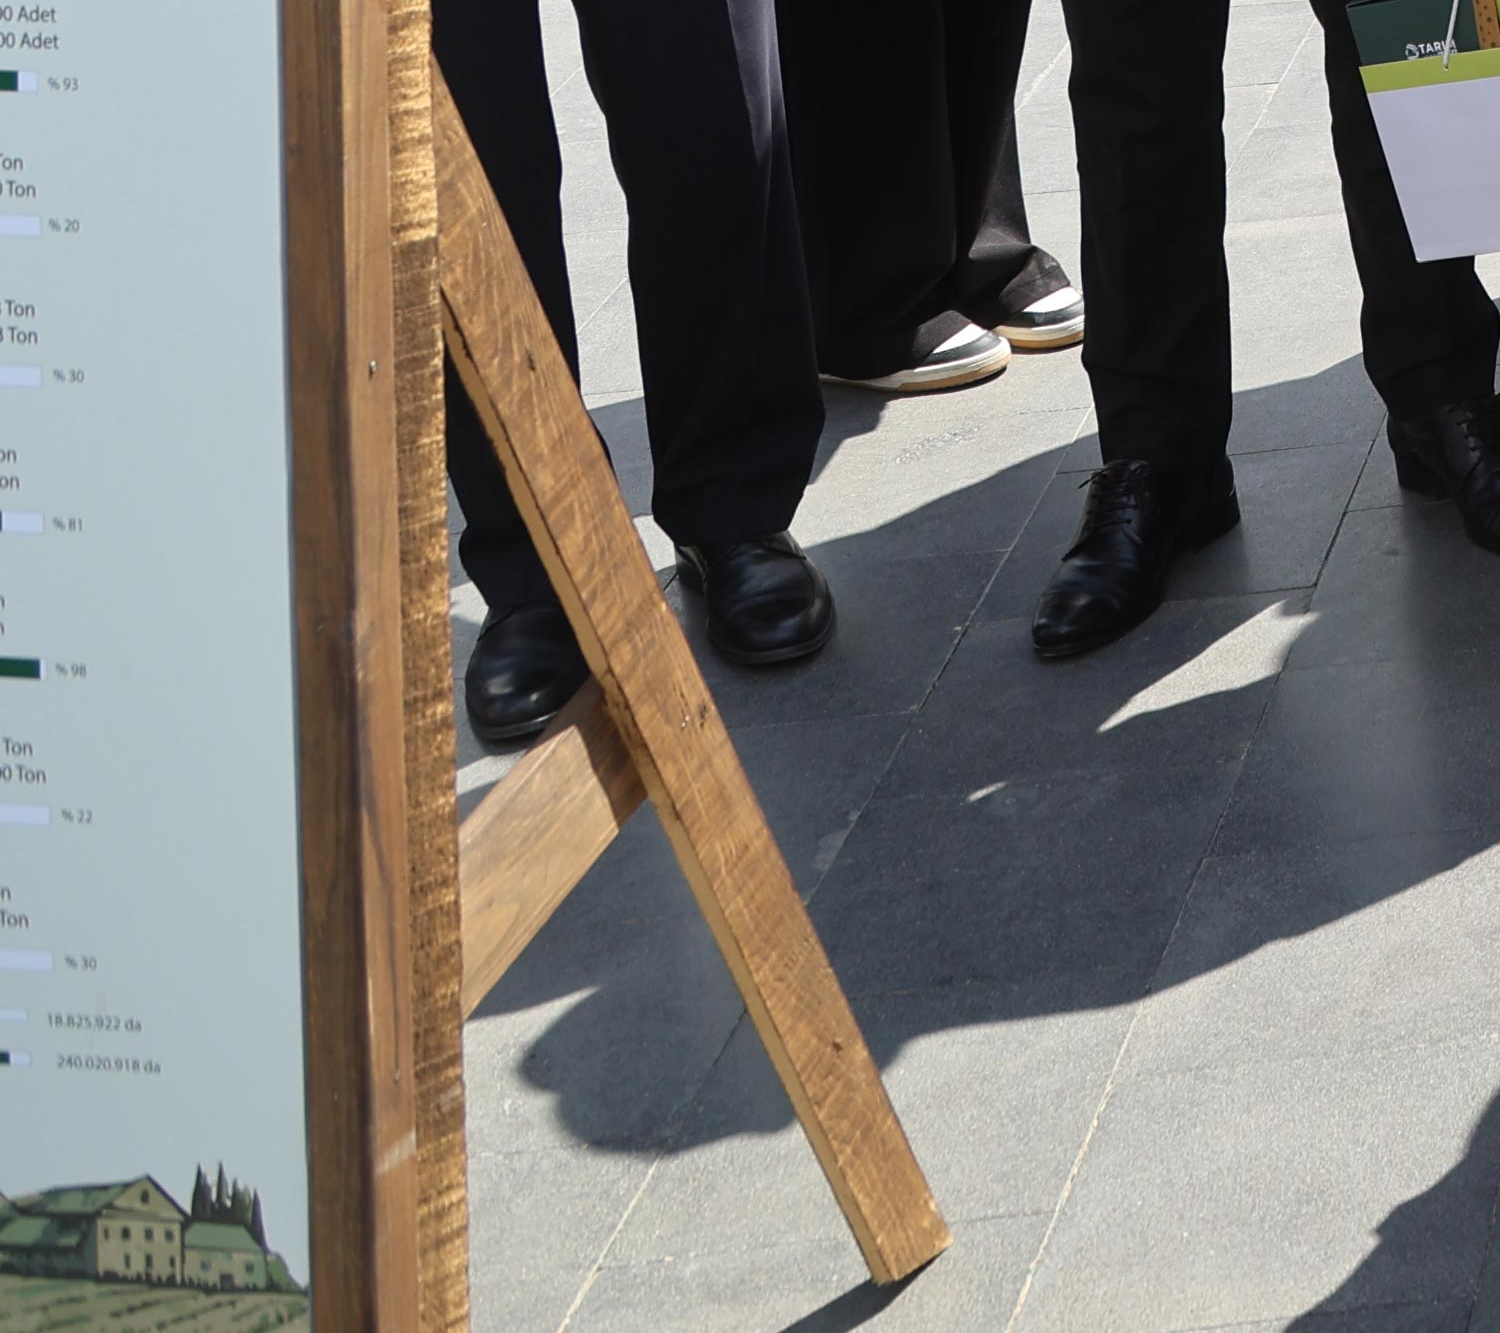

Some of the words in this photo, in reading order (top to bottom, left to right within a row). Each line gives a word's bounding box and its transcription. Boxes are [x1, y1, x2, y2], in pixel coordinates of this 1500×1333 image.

[17, 5, 57, 24] Adet
[20, 32, 60, 51] Adet
[6, 180, 37, 198] Ton
[5, 299, 36, 318] Ton
[8, 326, 39, 345] Ton
[0, 448, 17, 464] on
[0, 474, 20, 491] on
[3, 737, 34, 757] Ton
[16, 764, 47, 784] Ton
